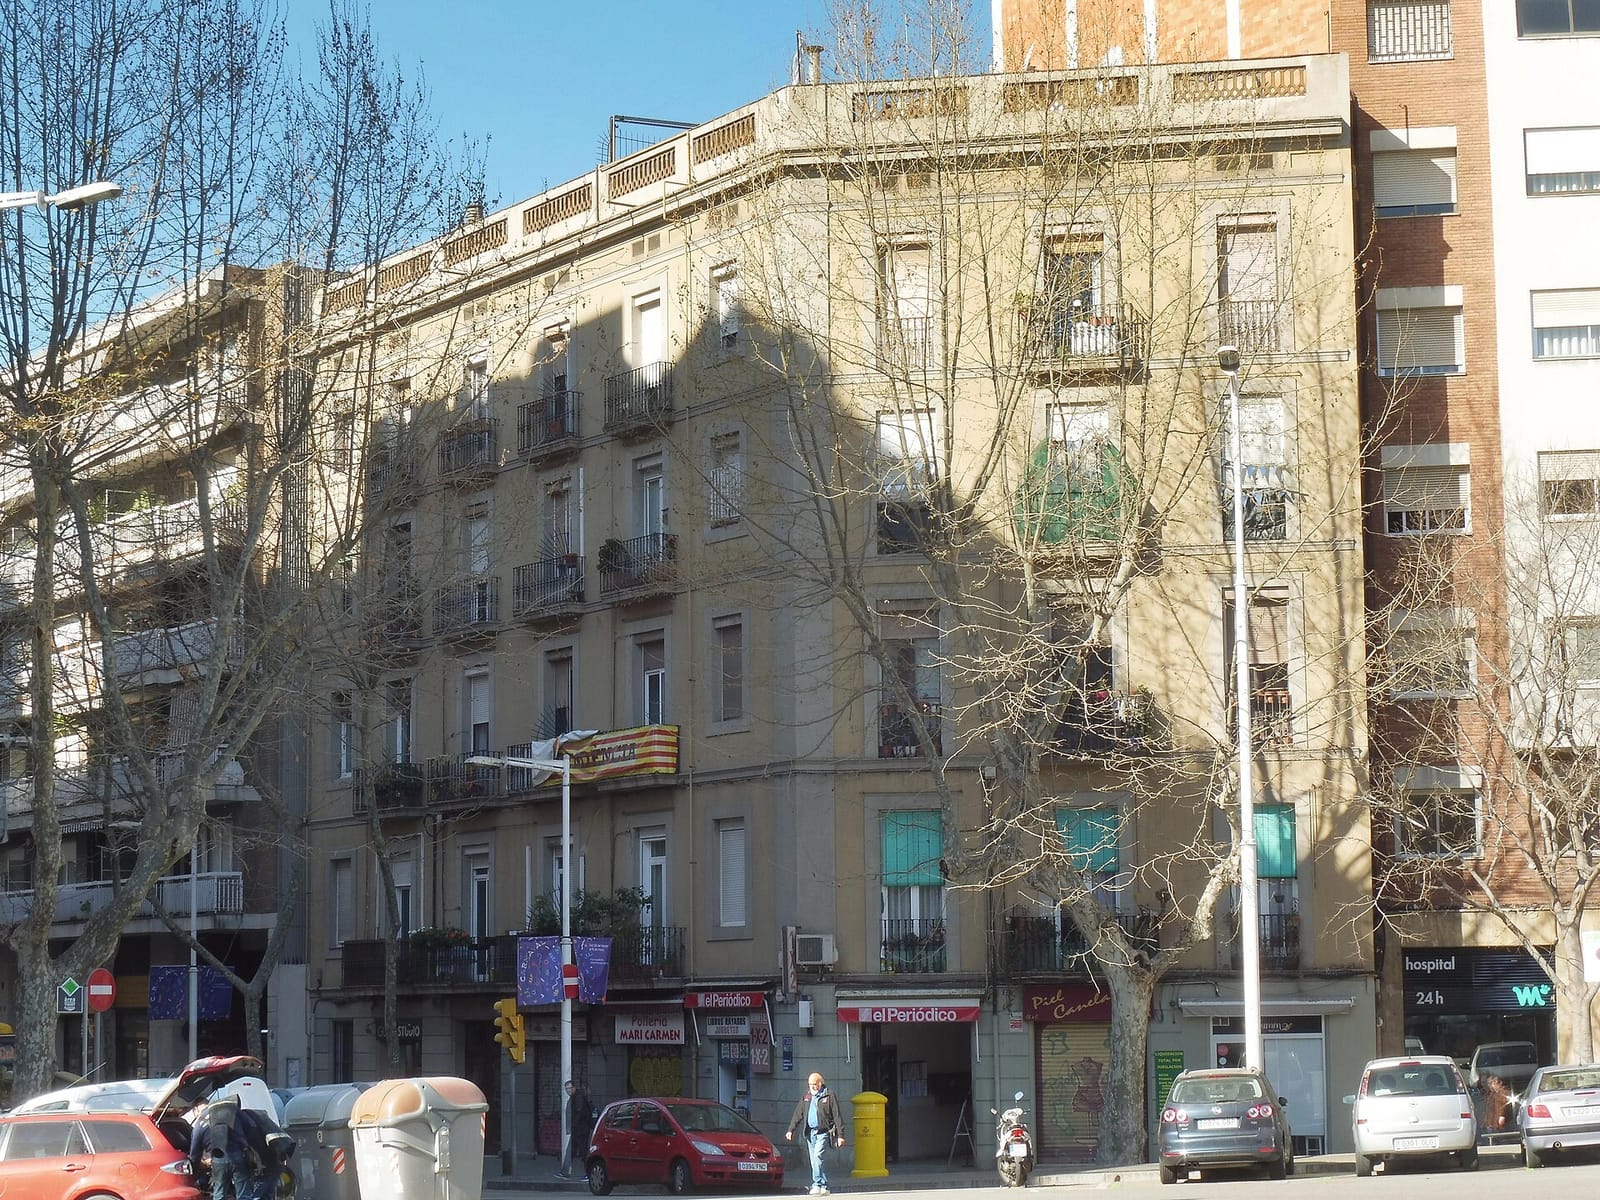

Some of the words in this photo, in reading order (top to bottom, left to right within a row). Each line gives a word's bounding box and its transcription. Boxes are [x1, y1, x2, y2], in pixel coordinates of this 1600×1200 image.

[1405, 956, 1456, 974] hospital
[1032, 989, 1065, 1009] Piel
[1053, 993, 1111, 1019] Canela
[1416, 991, 1433, 1005] 24
[1435, 991, 1444, 1005] h
[620, 1029, 643, 1041] MARI
[644, 1029, 681, 1041] CARMEN
